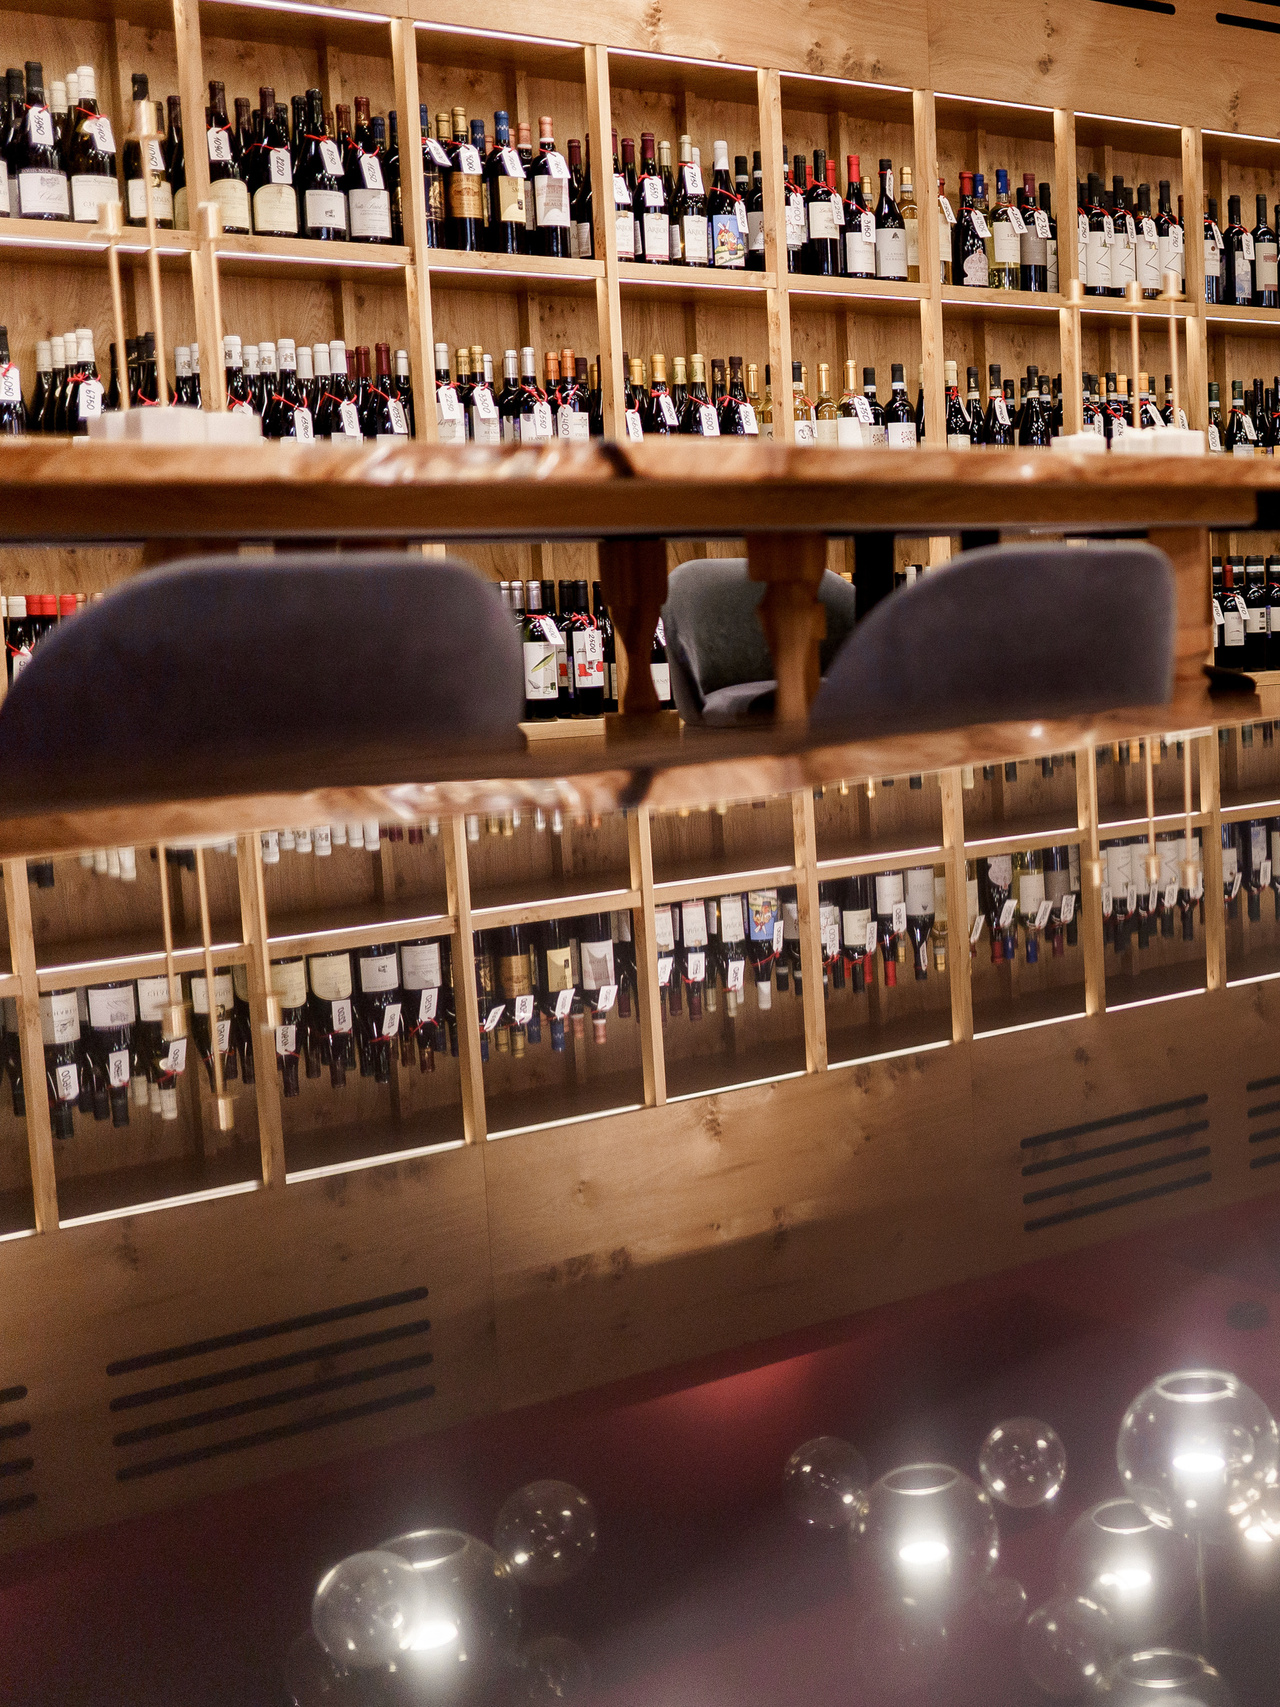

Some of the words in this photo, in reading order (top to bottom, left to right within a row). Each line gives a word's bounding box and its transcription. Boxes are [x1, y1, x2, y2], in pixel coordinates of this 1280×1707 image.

[275, 156, 285, 176] 8200
[649, 183, 659, 199] 6550
[793, 199, 801, 221] 2100
[86, 389, 96, 410] 6750
[539, 409, 547, 429] 2550
[561, 412, 570, 436] 2400
